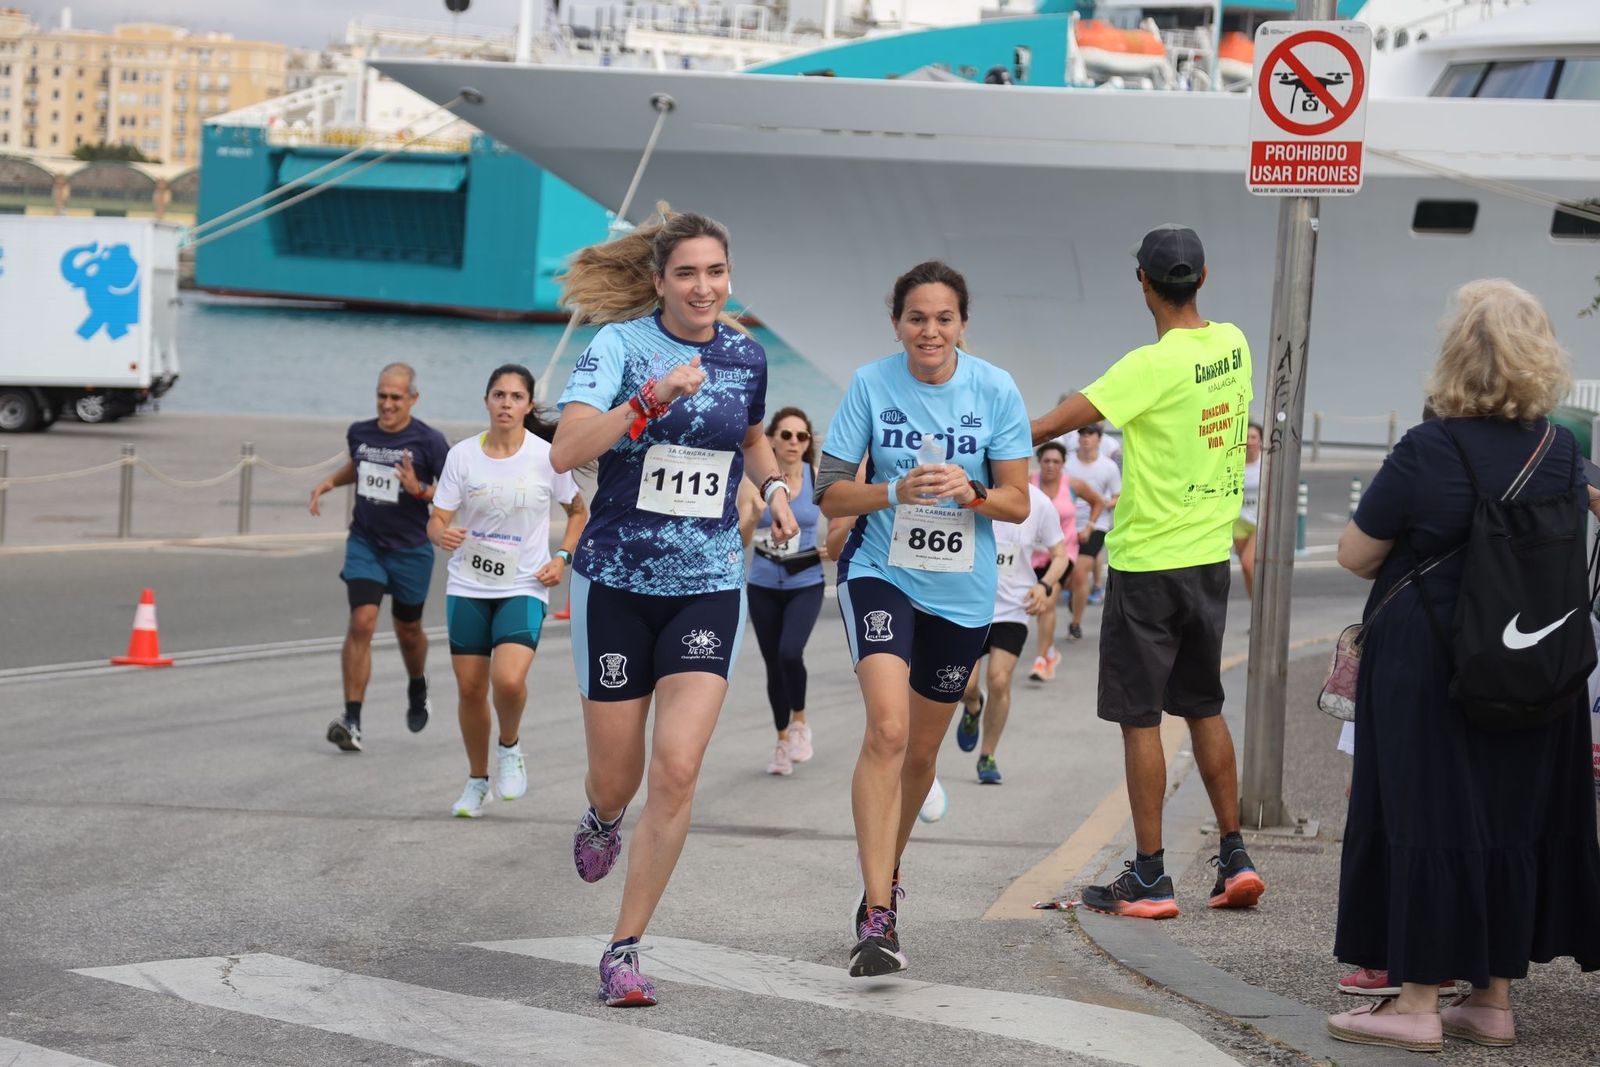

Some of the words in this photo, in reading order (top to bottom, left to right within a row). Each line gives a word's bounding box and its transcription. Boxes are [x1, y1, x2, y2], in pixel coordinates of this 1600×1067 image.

[1265, 144, 1348, 161] PROHIBIDO
[1252, 165, 1292, 182] USAR
[1296, 165, 1358, 182] DRONES
[366, 475, 391, 490] 901
[651, 467, 720, 496] 1113
[925, 509, 956, 517] CARRERA
[908, 527, 963, 553] 866
[471, 555, 505, 576] 868
[688, 648, 715, 656] NERJA
